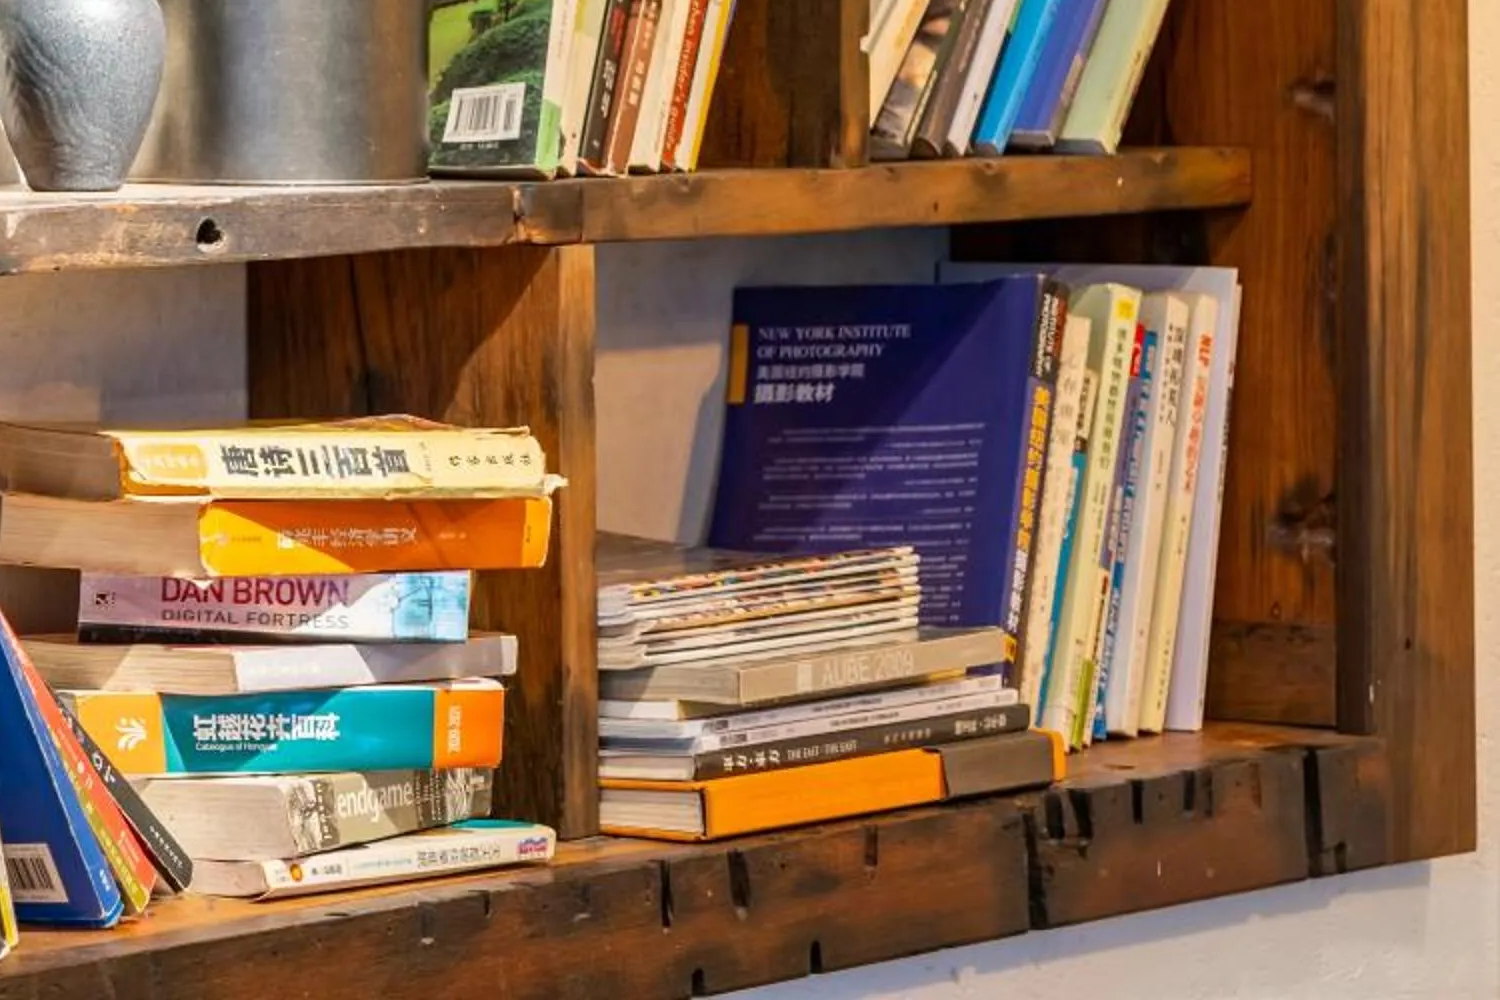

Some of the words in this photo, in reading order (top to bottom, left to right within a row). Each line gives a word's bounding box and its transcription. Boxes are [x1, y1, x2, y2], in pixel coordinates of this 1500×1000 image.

[757, 326, 791, 341] NEW
[795, 326, 835, 341] YORK
[837, 323, 912, 340] INSTITUTE
[756, 345, 774, 359] OF
[778, 342, 884, 359] PHOTOGRAPHY
[220, 442, 412, 479] 唐诗三百首
[160, 576, 225, 604] DAN
[231, 577, 350, 607] BROWN
[160, 610, 239, 626] DIGITAL
[245, 612, 350, 630] FORTRESS
[192, 711, 341, 742] 虹越花卉百科
[337, 779, 415, 822] endgame
